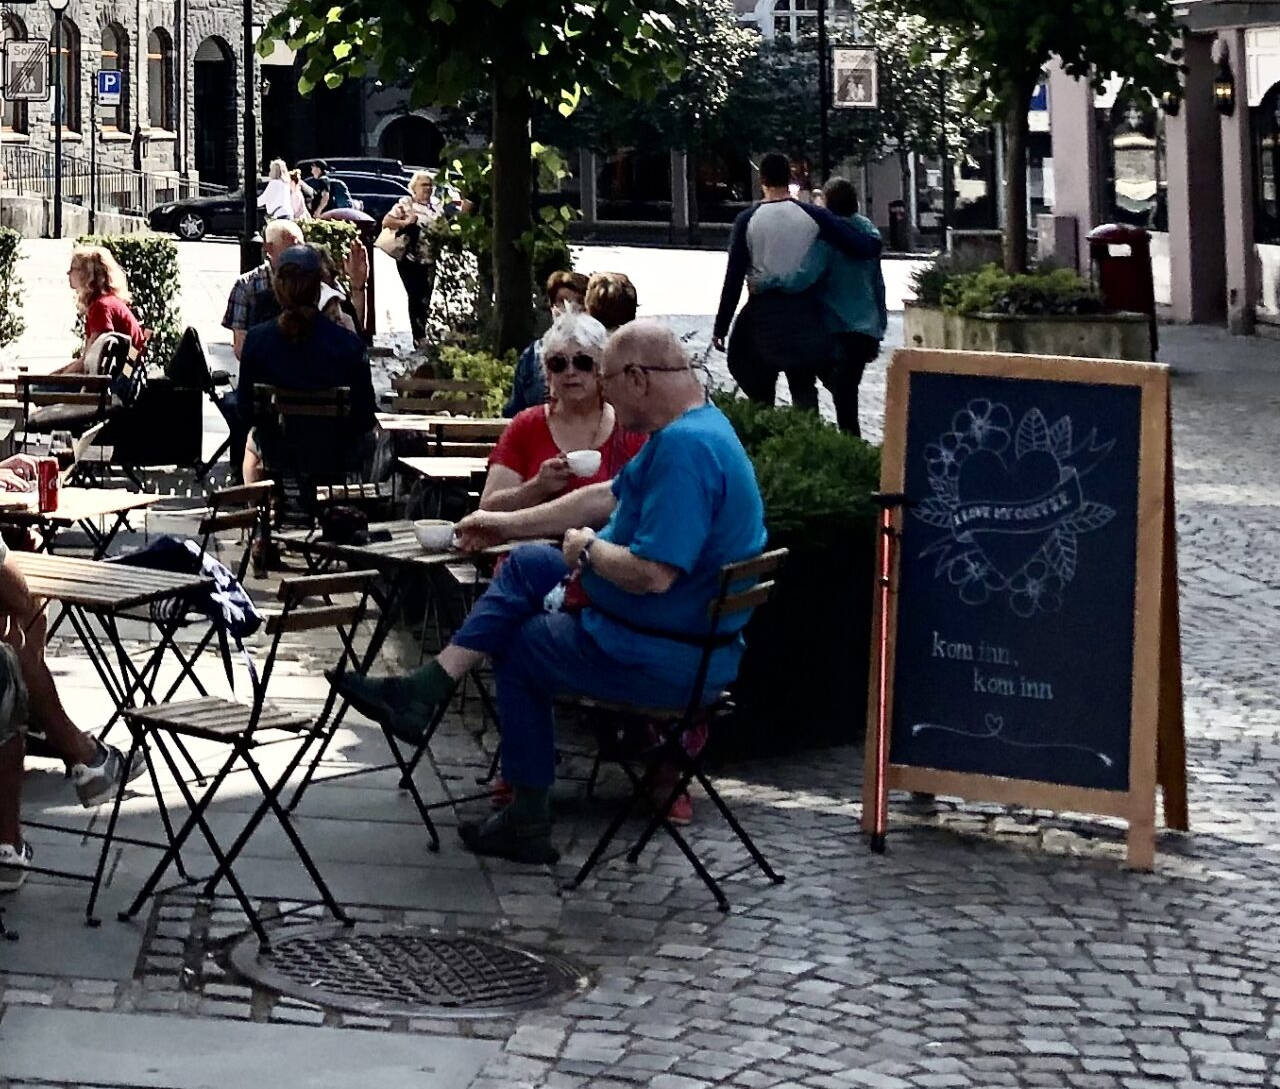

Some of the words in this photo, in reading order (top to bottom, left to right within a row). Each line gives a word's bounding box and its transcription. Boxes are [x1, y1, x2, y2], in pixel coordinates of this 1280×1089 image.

[104, 74, 116, 92] P
[931, 630, 973, 660] kom
[973, 666, 1015, 695] kom
[1020, 675, 1053, 700] inn
